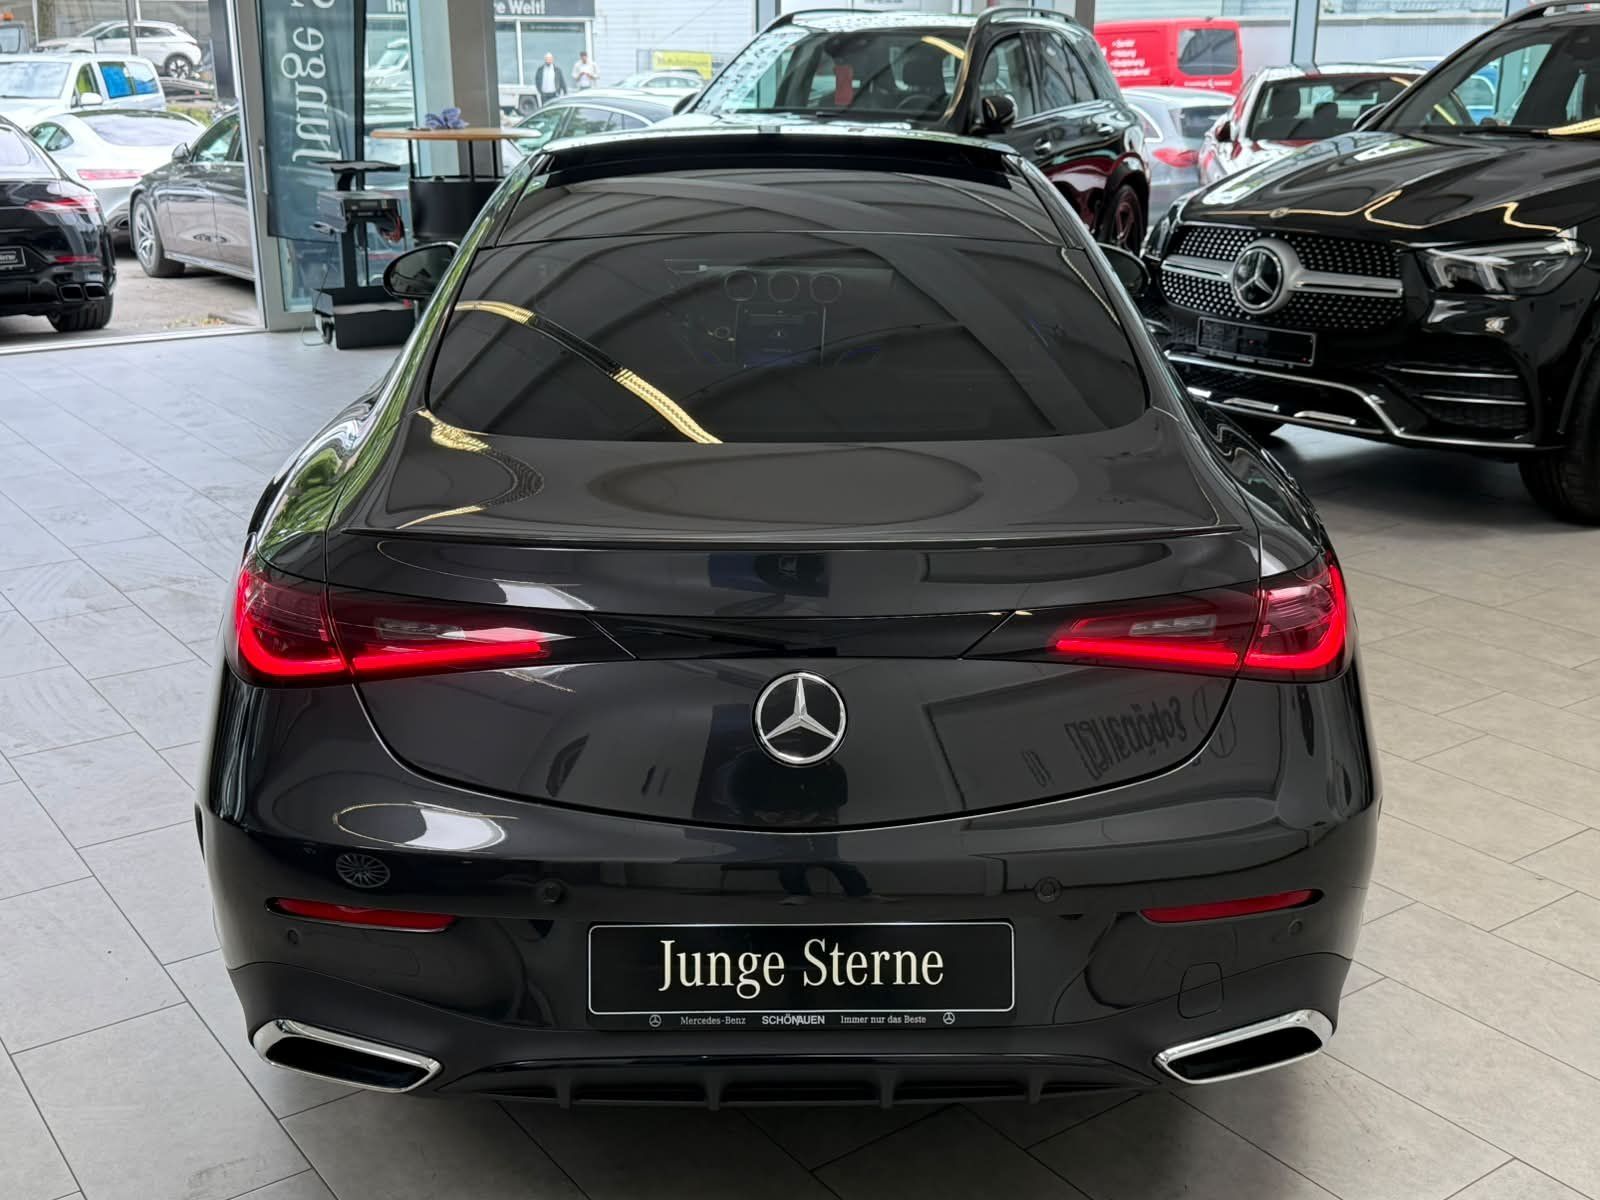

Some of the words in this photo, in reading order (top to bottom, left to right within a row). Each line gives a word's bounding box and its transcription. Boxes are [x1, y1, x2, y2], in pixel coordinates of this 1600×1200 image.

[508, 0, 545, 15] Welt!
[658, 939, 785, 999] Junge
[803, 938, 944, 987] Sterne
[680, 1015, 747, 1025] Mercedes-Benz
[761, 1013, 826, 1026] SCHÖNAUEN
[840, 1015, 868, 1024] Immer
[887, 1015, 902, 1024] das
[904, 1015, 927, 1024] Beste
